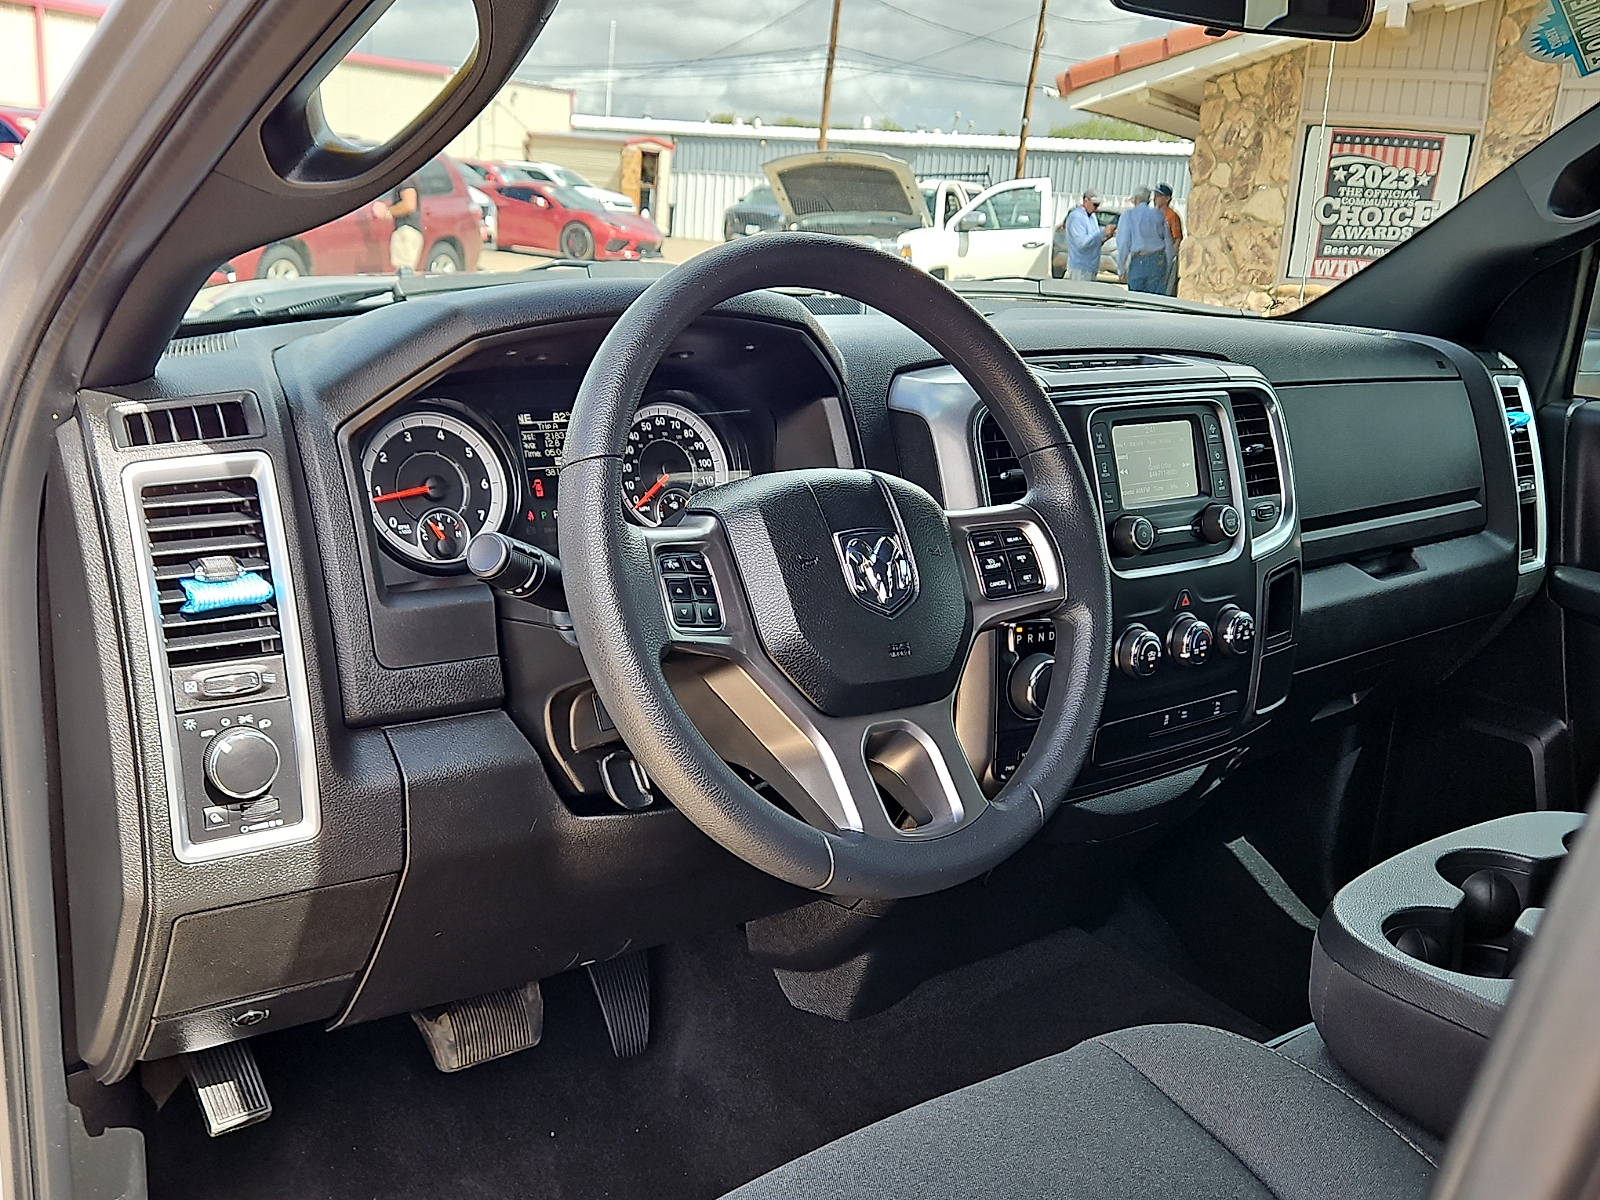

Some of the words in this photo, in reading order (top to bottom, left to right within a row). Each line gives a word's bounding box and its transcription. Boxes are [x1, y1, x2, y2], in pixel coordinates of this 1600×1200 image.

[1346, 163, 1417, 190] 2023
[1338, 186, 1364, 197] THE
[1363, 188, 1421, 200] OFFICIAL
[1341, 196, 1415, 208] COMMUNITY'S
[1314, 195, 1442, 228] CHOICE
[1330, 225, 1414, 240] AWARDS
[1323, 244, 1349, 256] Best
[1350, 244, 1364, 256] of
[641, 422, 652, 431] 50
[655, 417, 665, 426] 60
[670, 420, 681, 430] 70
[404, 431, 413, 442] 3
[437, 430, 445, 441] 4
[629, 431, 639, 441] 40
[683, 429, 694, 438] 80
[693, 441, 704, 451] 90
[379, 452, 388, 463] 2
[465, 447, 473, 458] 5
[698, 458, 712, 468] 100
[480, 479, 489, 489] 6
[624, 480, 635, 490] 10
[700, 475, 714, 485] 110
[477, 510, 485, 521] 7
[1016, 634, 1023, 645] P
[1027, 633, 1034, 643] R
[1038, 632, 1045, 642] N
[1048, 631, 1055, 641] D
